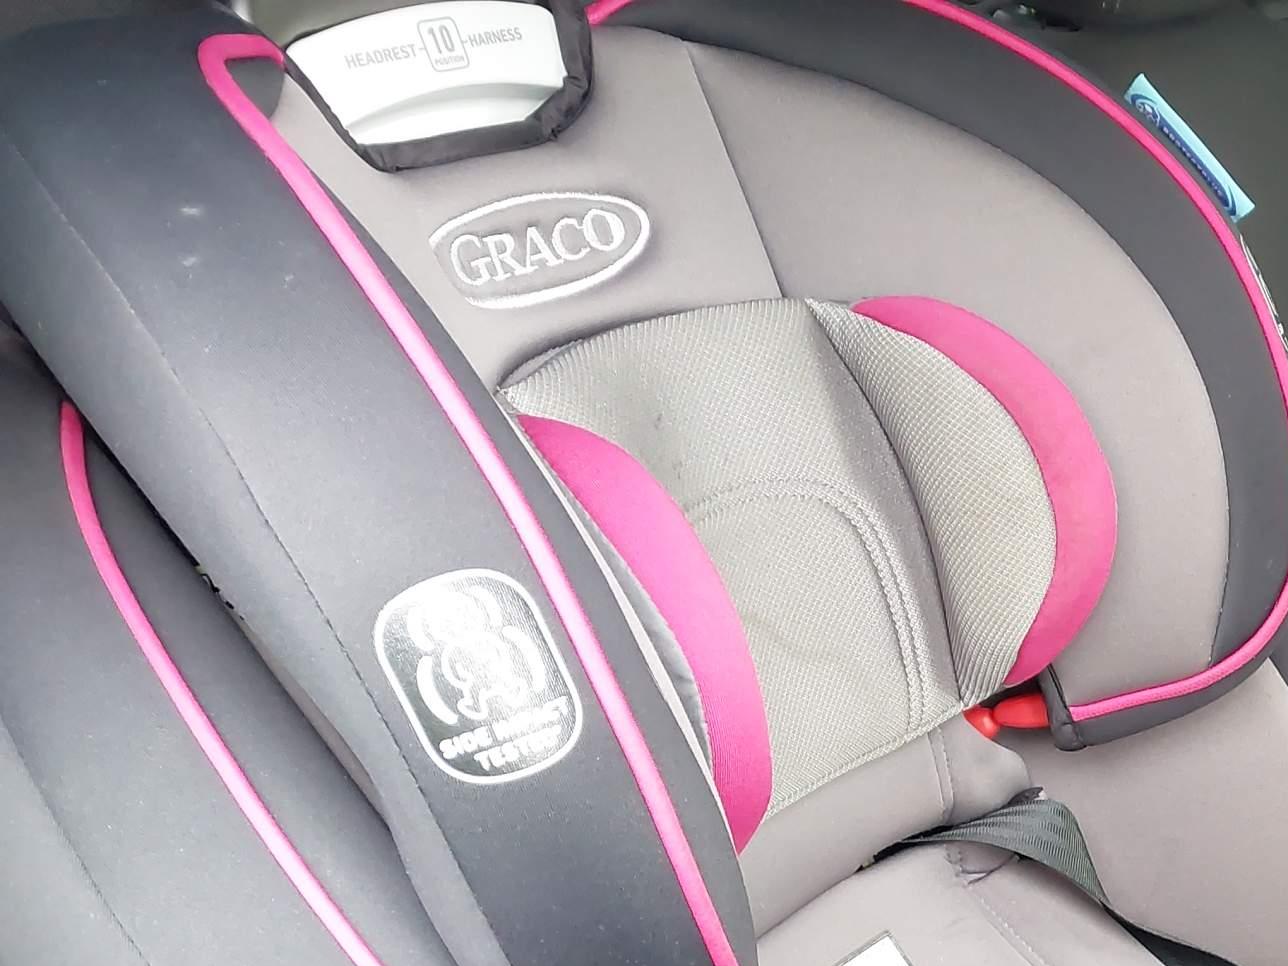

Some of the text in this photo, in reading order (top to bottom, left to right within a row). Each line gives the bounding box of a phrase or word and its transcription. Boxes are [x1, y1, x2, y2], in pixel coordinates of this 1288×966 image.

[344, 24, 523, 70] HEADREST 10 HARNESS
[450, 208, 625, 286] GRACO
